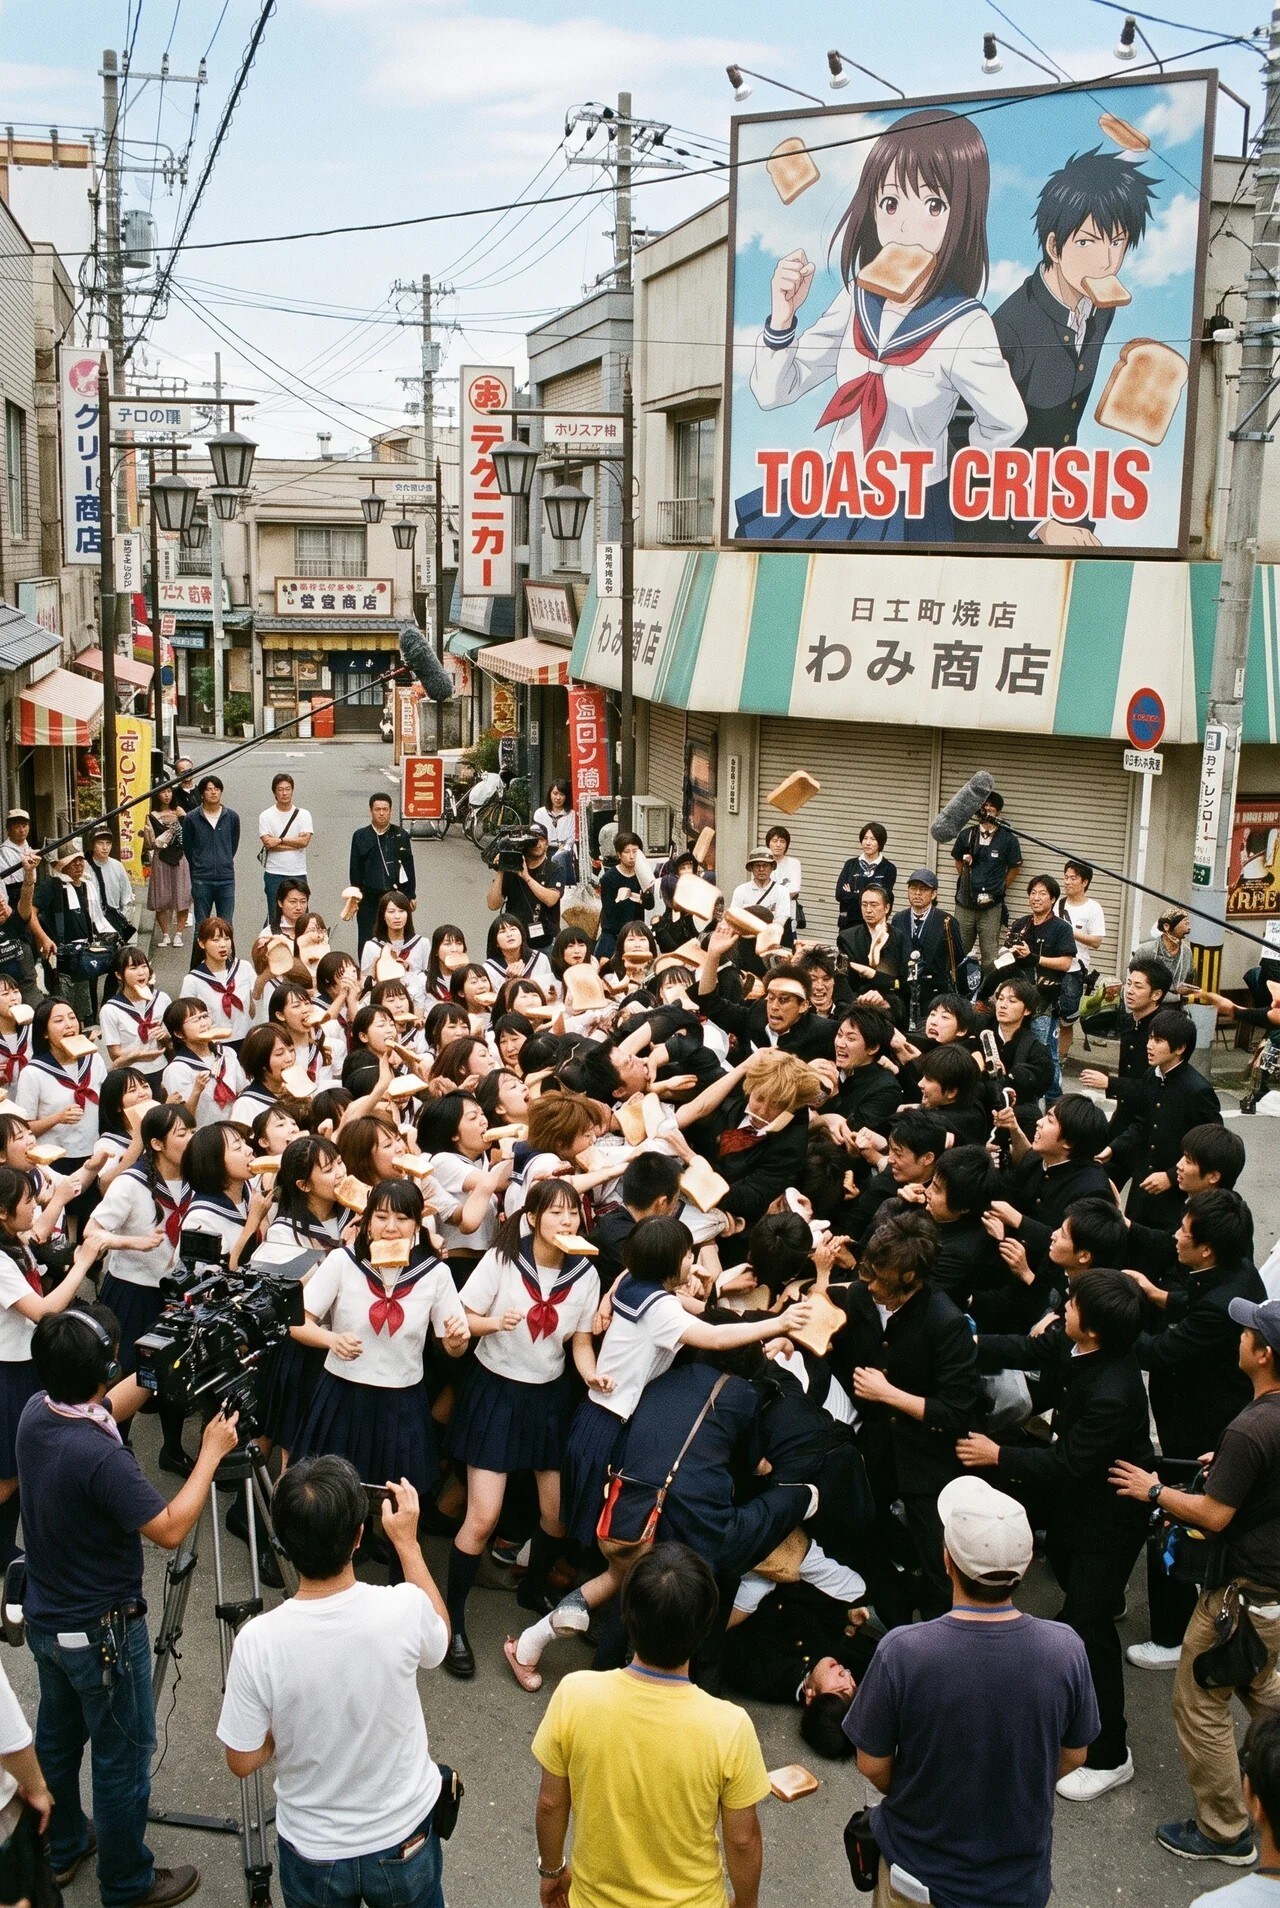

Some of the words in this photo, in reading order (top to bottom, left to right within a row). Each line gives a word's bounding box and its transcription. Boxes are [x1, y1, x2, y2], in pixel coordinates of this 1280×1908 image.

[756, 448, 935, 519] TOAST
[949, 447, 1152, 521] CRISIS
[804, 634, 1052, 696] わみ商店
